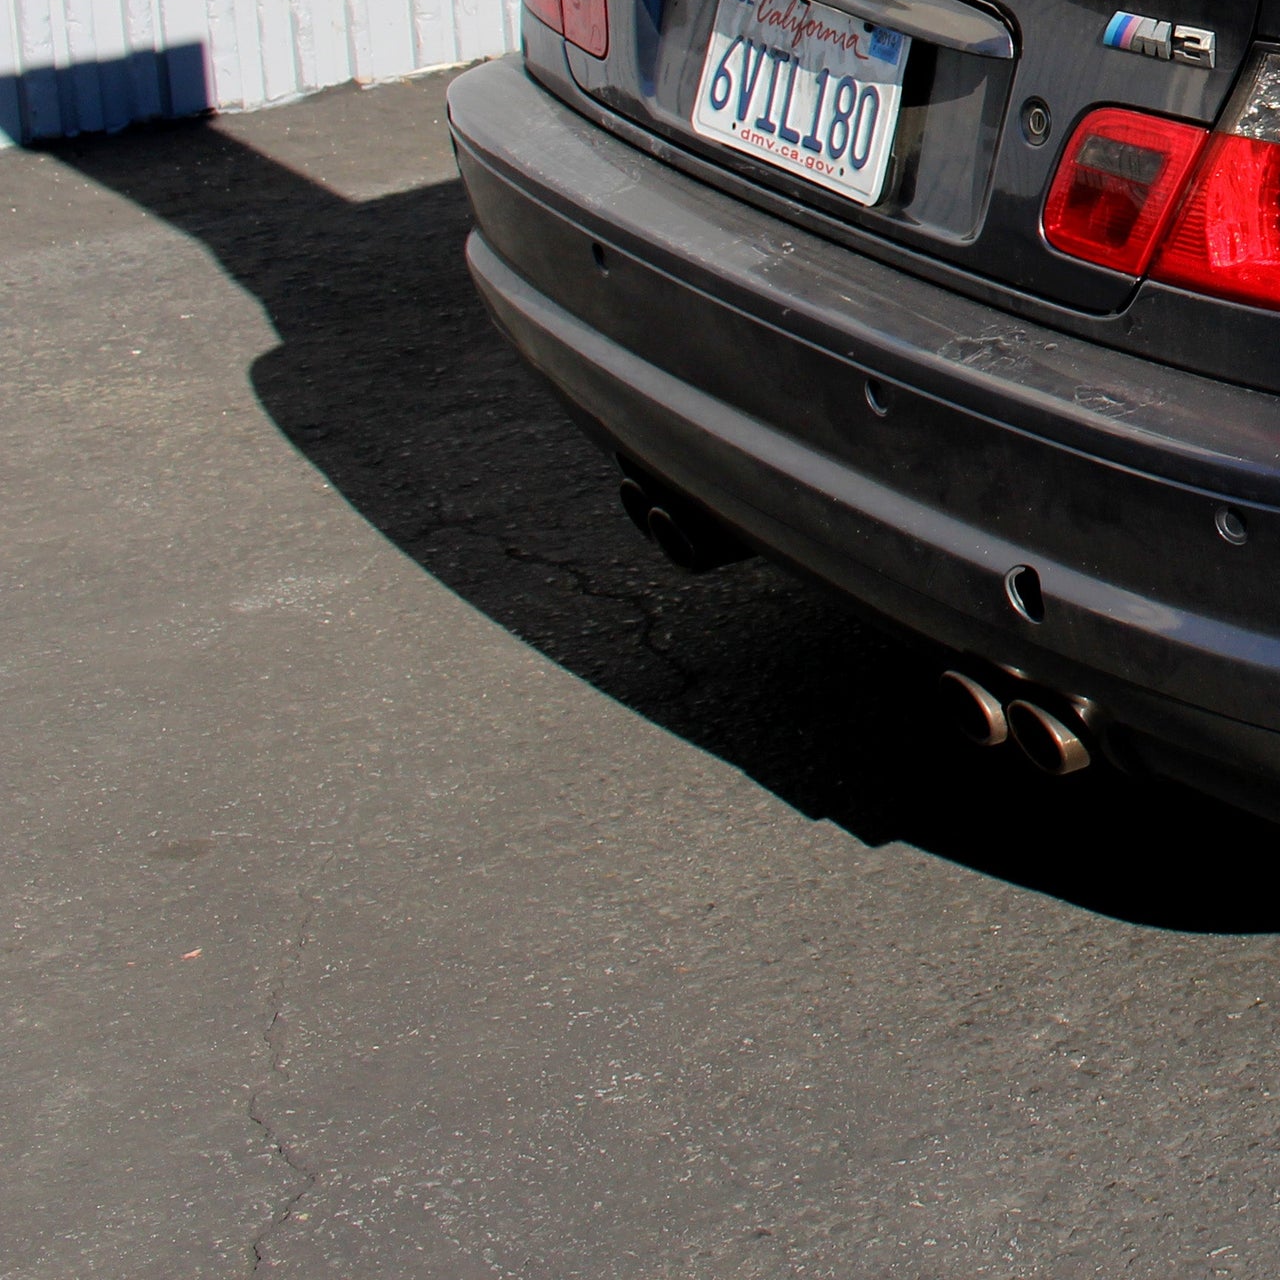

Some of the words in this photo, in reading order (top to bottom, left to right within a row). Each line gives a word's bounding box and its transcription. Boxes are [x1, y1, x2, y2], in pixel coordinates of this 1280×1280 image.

[1130, 16, 1216, 69] M3
[711, 34, 881, 172] 6VIL180
[740, 126, 836, 176] dmv.ca.gov
